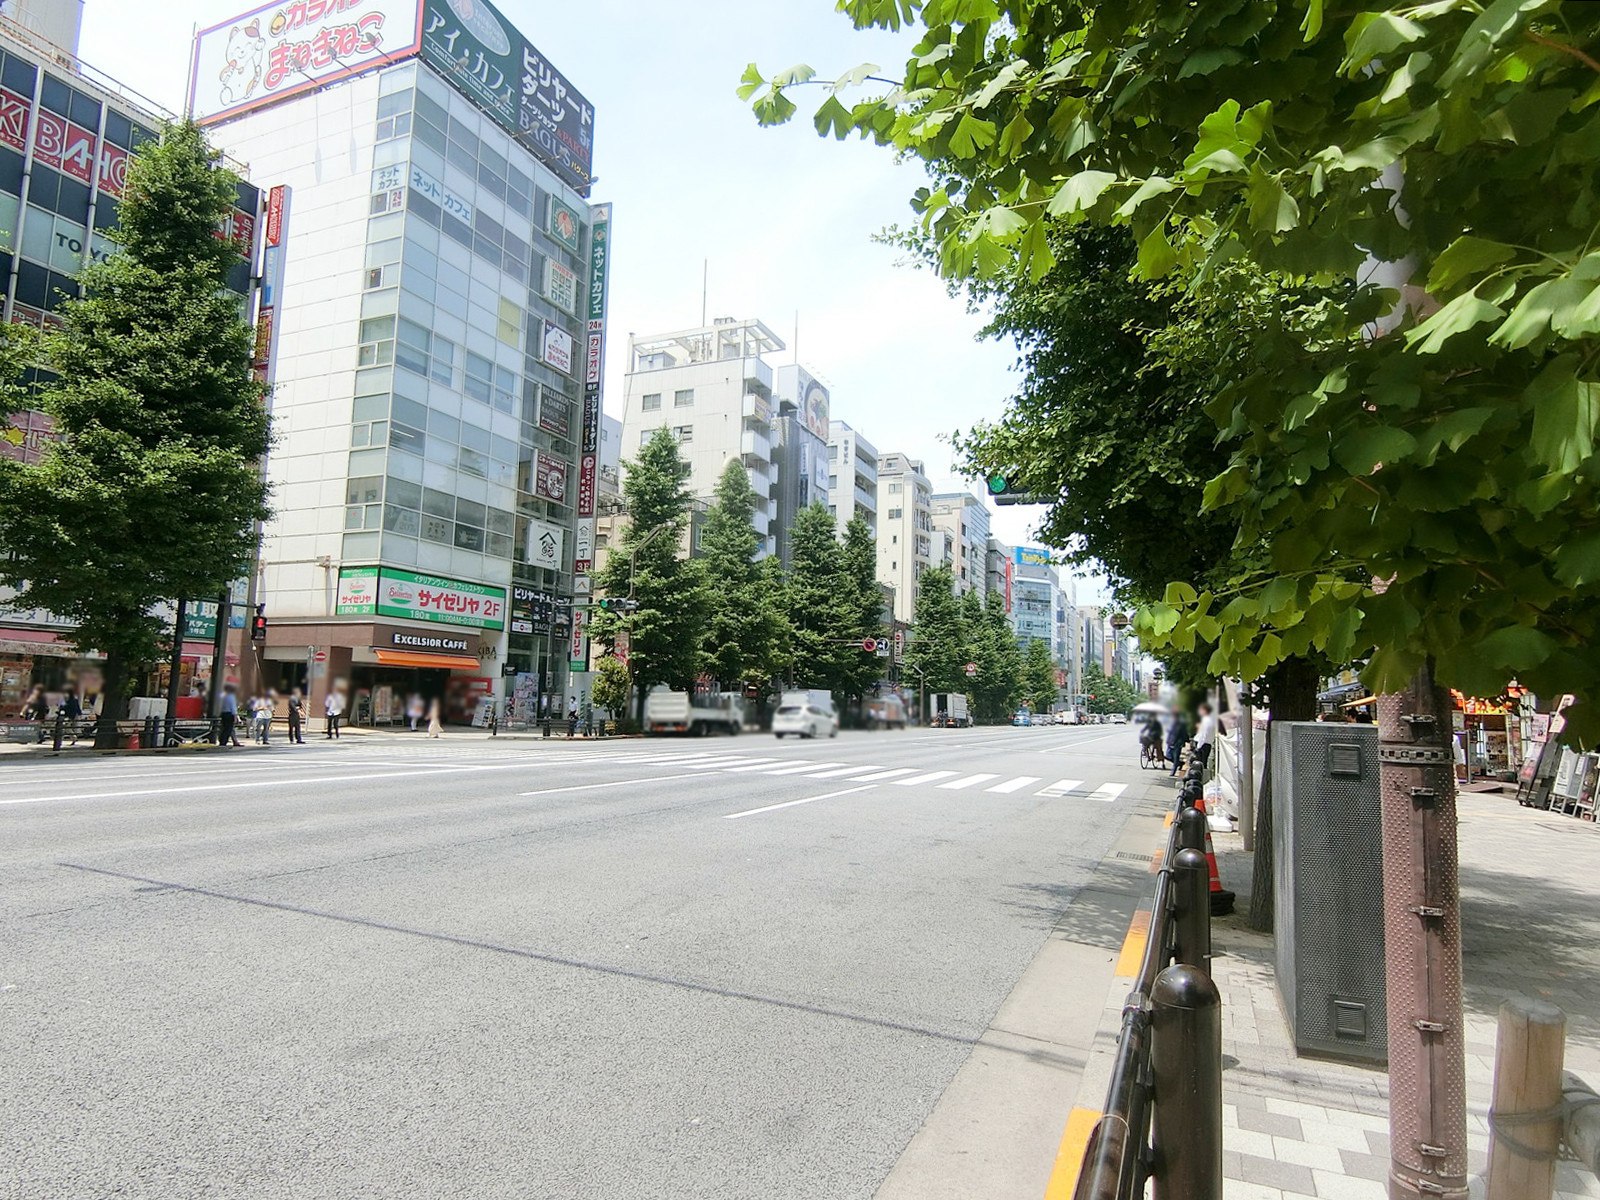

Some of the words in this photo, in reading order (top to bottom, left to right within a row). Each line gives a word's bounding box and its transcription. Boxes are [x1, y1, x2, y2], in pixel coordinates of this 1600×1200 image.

[265, 12, 385, 89] まねきねこ
[522, 73, 566, 122] ダーツ
[523, 47, 592, 126] ビリヤード
[592, 246, 605, 315] ネットカフェ
[589, 338, 599, 379] カラオケ
[418, 590, 479, 614] サイゼリヤ
[483, 600, 500, 616] 2F
[394, 633, 442, 649] EXCELSIOR
[573, 612, 583, 657] サイゼリヤ
